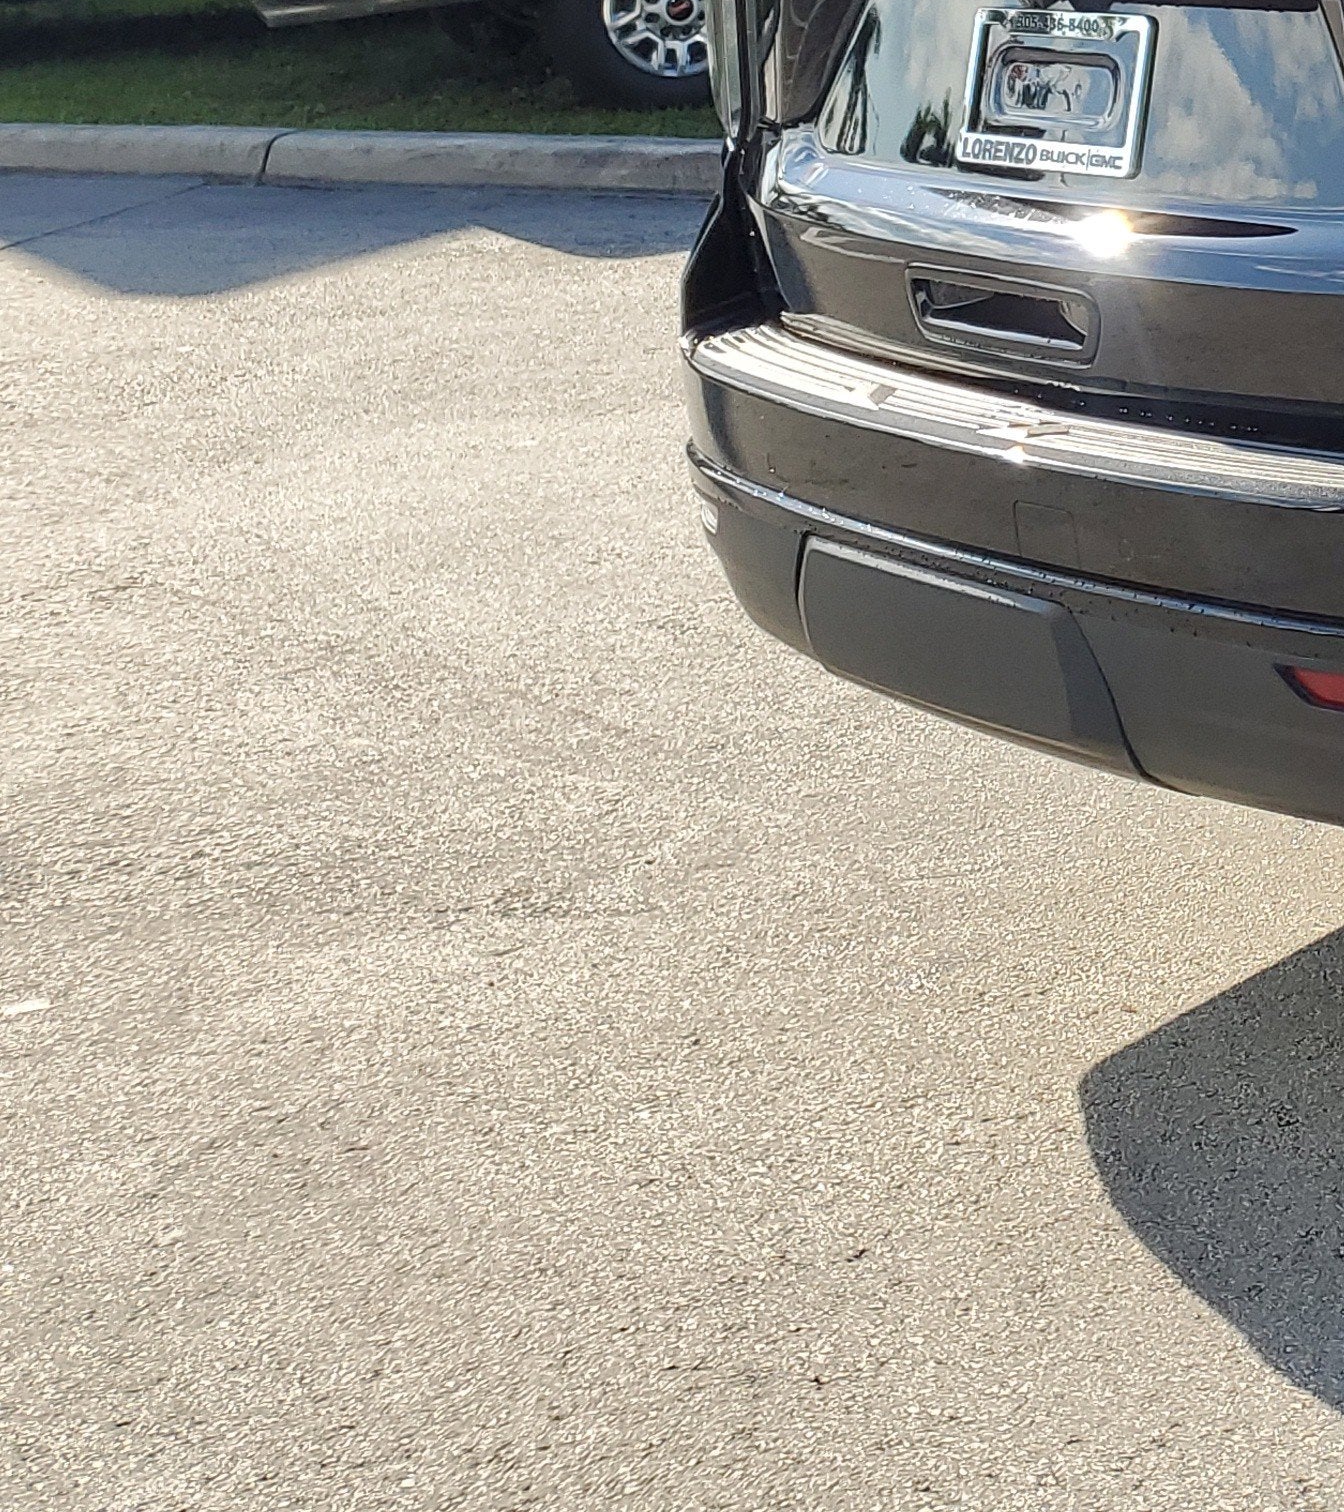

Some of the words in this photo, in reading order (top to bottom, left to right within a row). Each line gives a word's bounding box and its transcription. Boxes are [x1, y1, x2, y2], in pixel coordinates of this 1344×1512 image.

[961, 136, 1038, 165] LORENZO
[1039, 149, 1086, 166] BUICK
[1089, 153, 1123, 170] GMC
